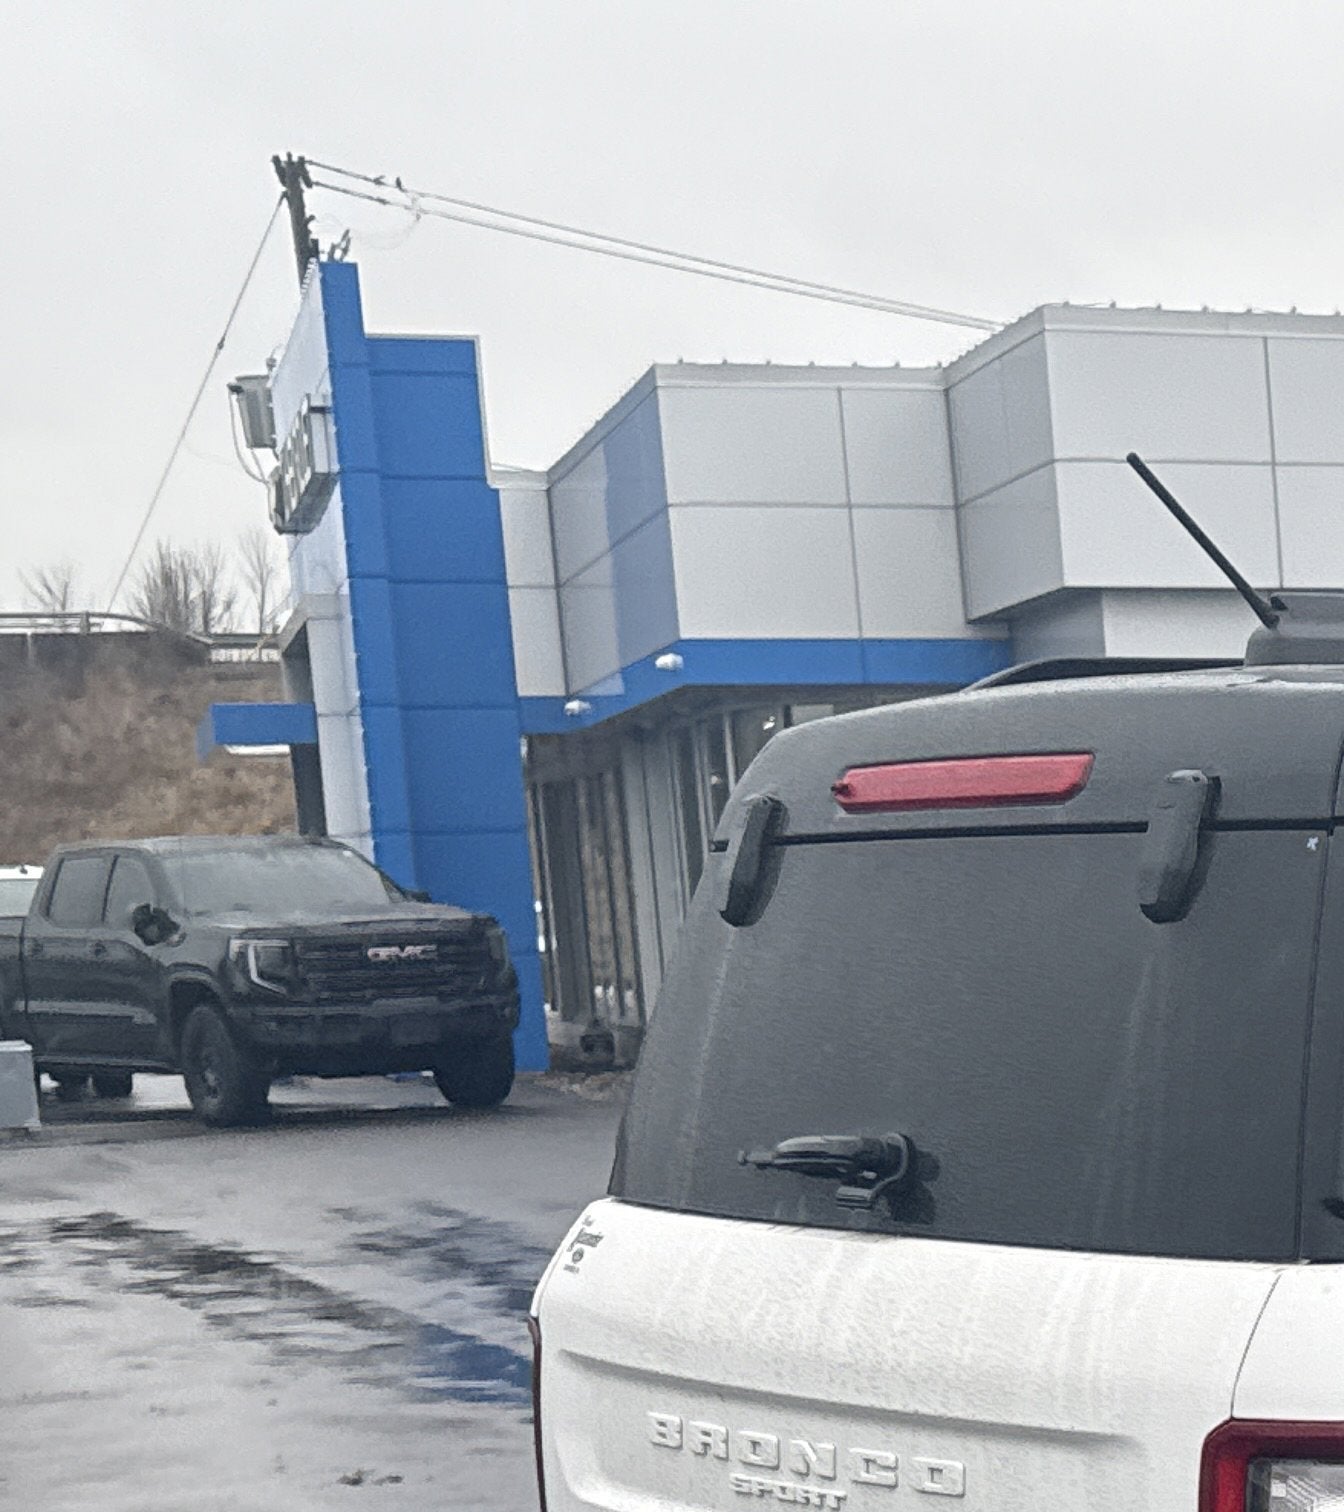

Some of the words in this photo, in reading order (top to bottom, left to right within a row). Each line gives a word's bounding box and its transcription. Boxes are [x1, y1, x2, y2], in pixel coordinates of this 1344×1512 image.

[367, 944, 438, 961] GMC
[647, 1411, 966, 1498] BRONCO
[729, 1472, 847, 1509] SPORT
